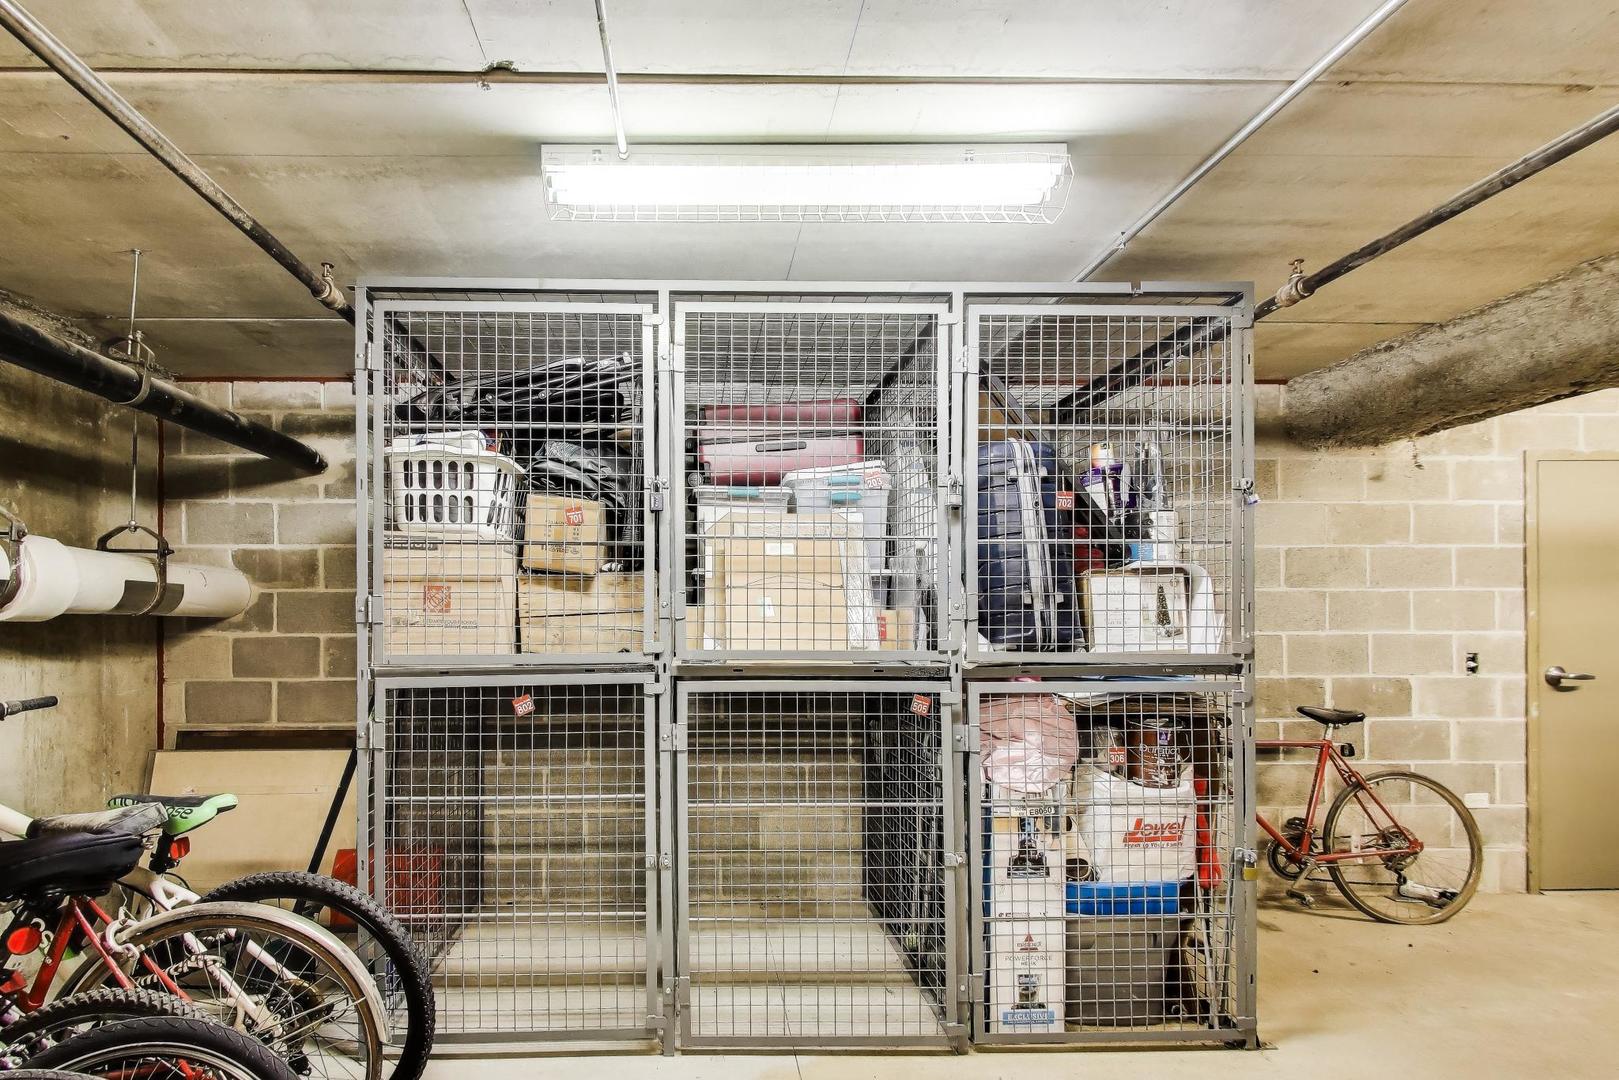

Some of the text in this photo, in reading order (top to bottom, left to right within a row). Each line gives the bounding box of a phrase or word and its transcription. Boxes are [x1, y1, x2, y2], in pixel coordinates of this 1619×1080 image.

[1058, 499, 1072, 508] 702
[568, 514, 583, 524] 701
[912, 702, 928, 714] 505
[1109, 754, 1125, 763] 306
